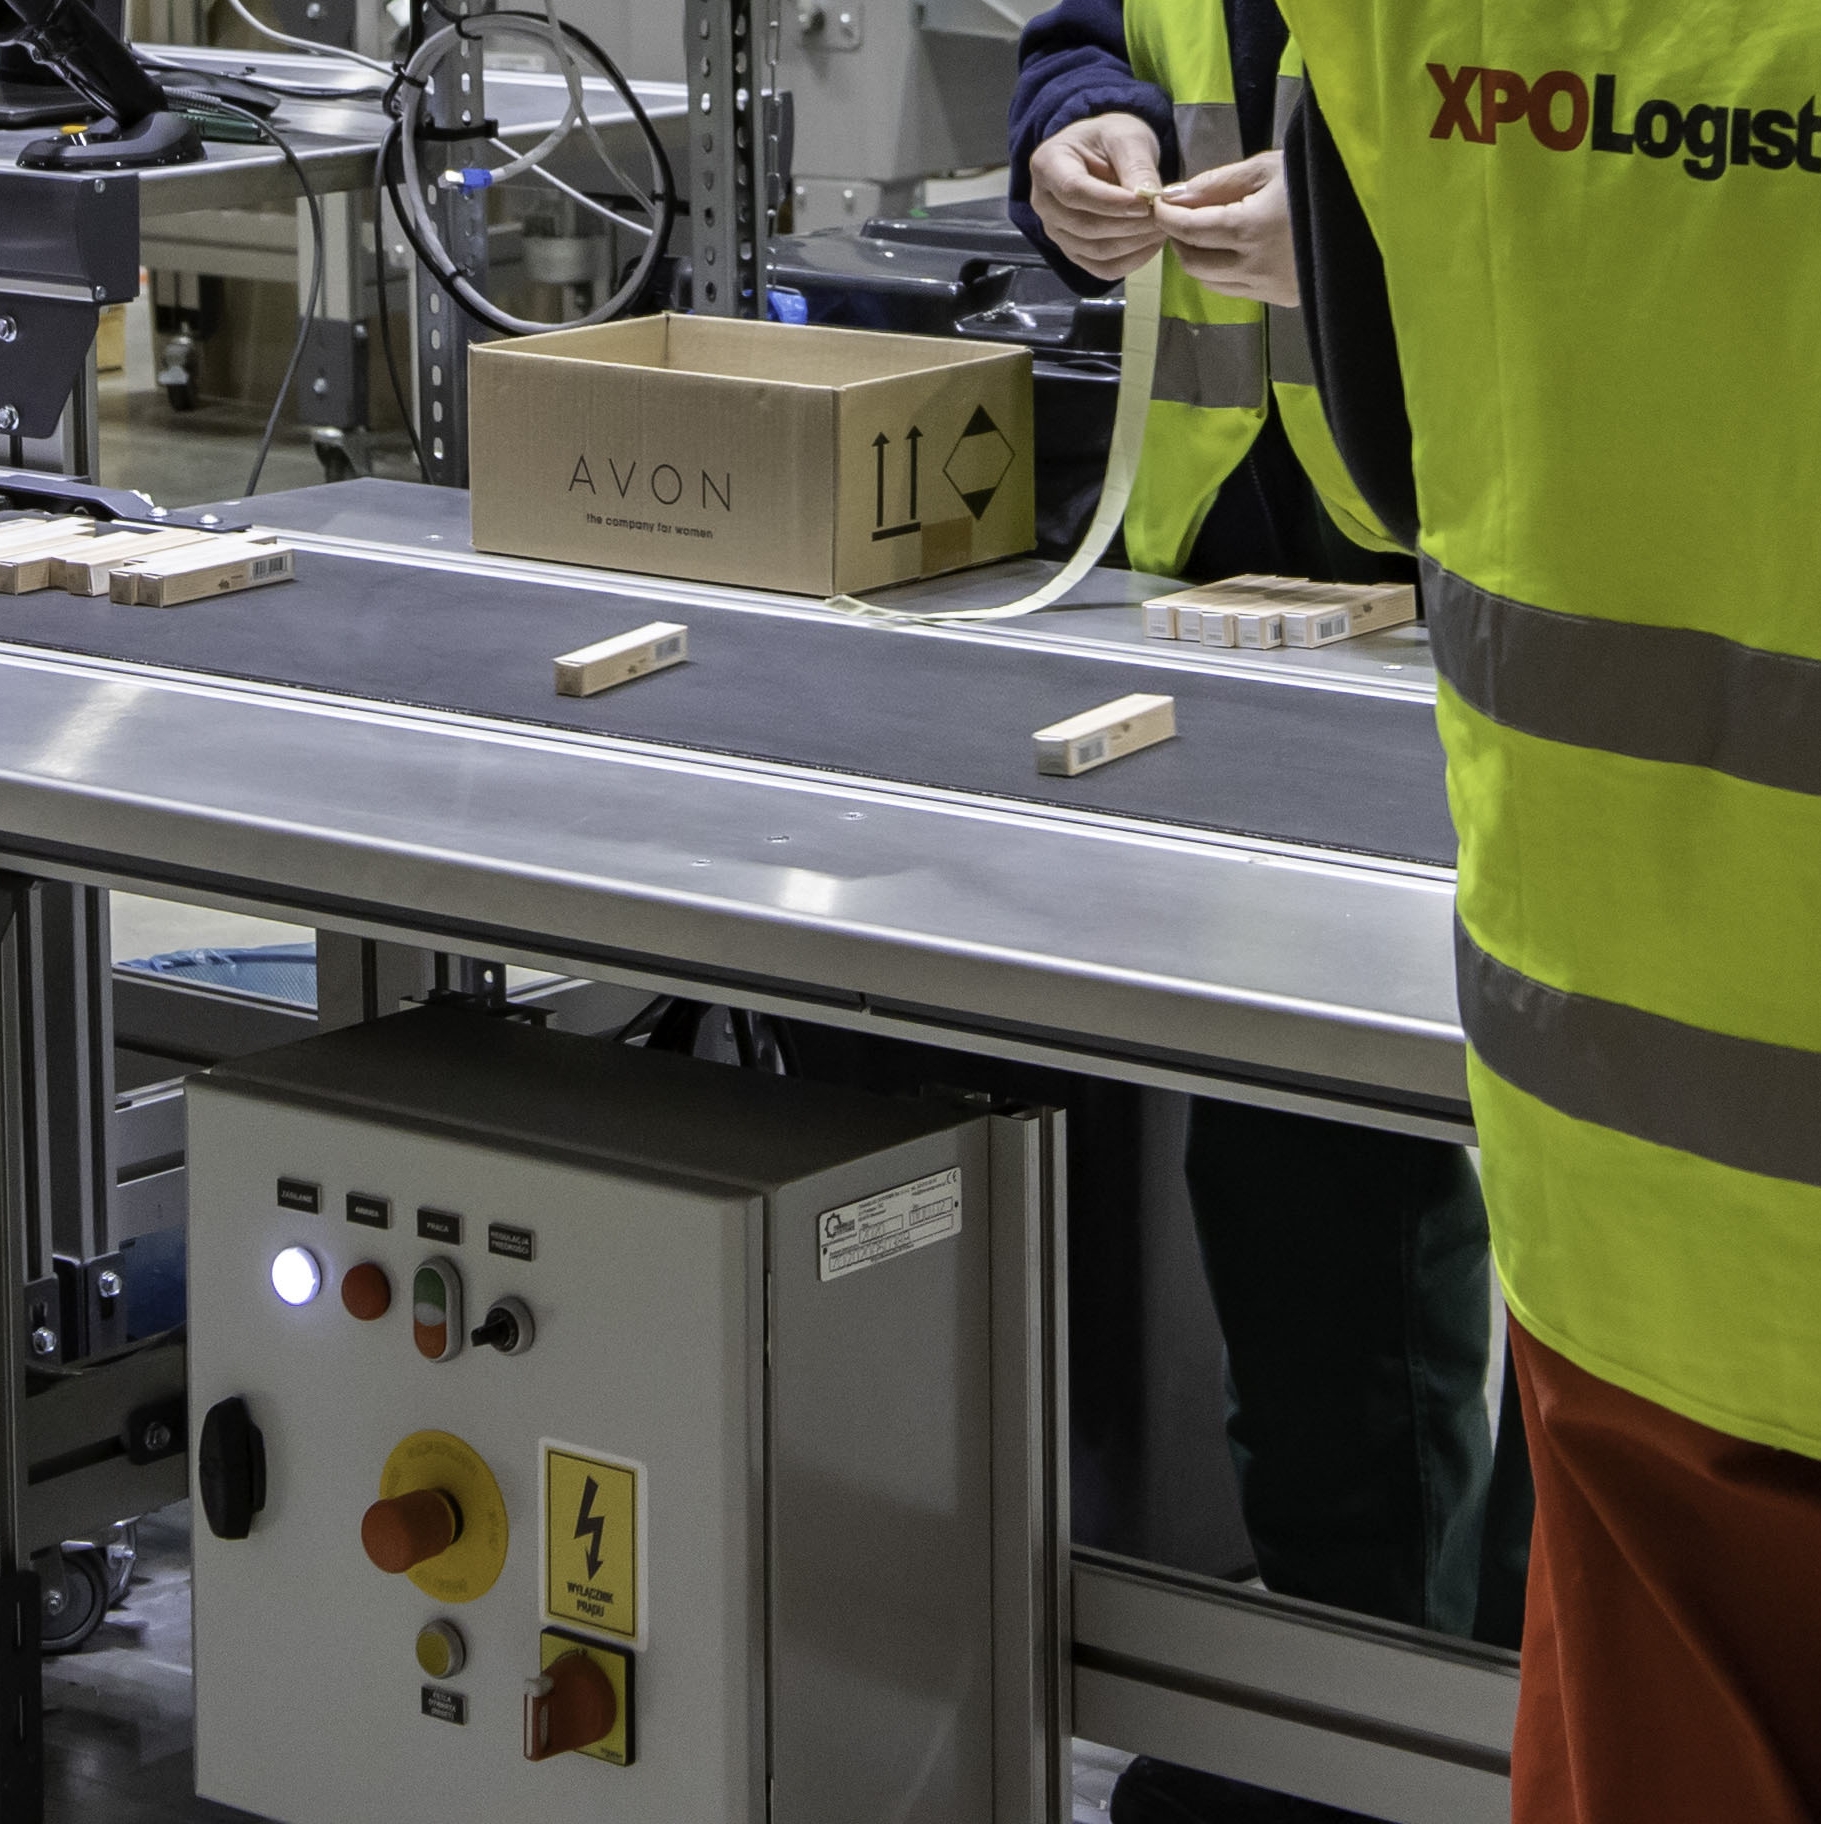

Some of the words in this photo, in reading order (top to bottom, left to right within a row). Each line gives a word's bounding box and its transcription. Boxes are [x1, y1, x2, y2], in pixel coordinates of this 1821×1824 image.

[568, 454, 731, 512] AVON
[586, 512, 603, 525] the
[605, 517, 655, 533] company
[657, 521, 672, 534] for
[675, 526, 713, 539] women
[576, 1599, 605, 1617] PRĄDU
